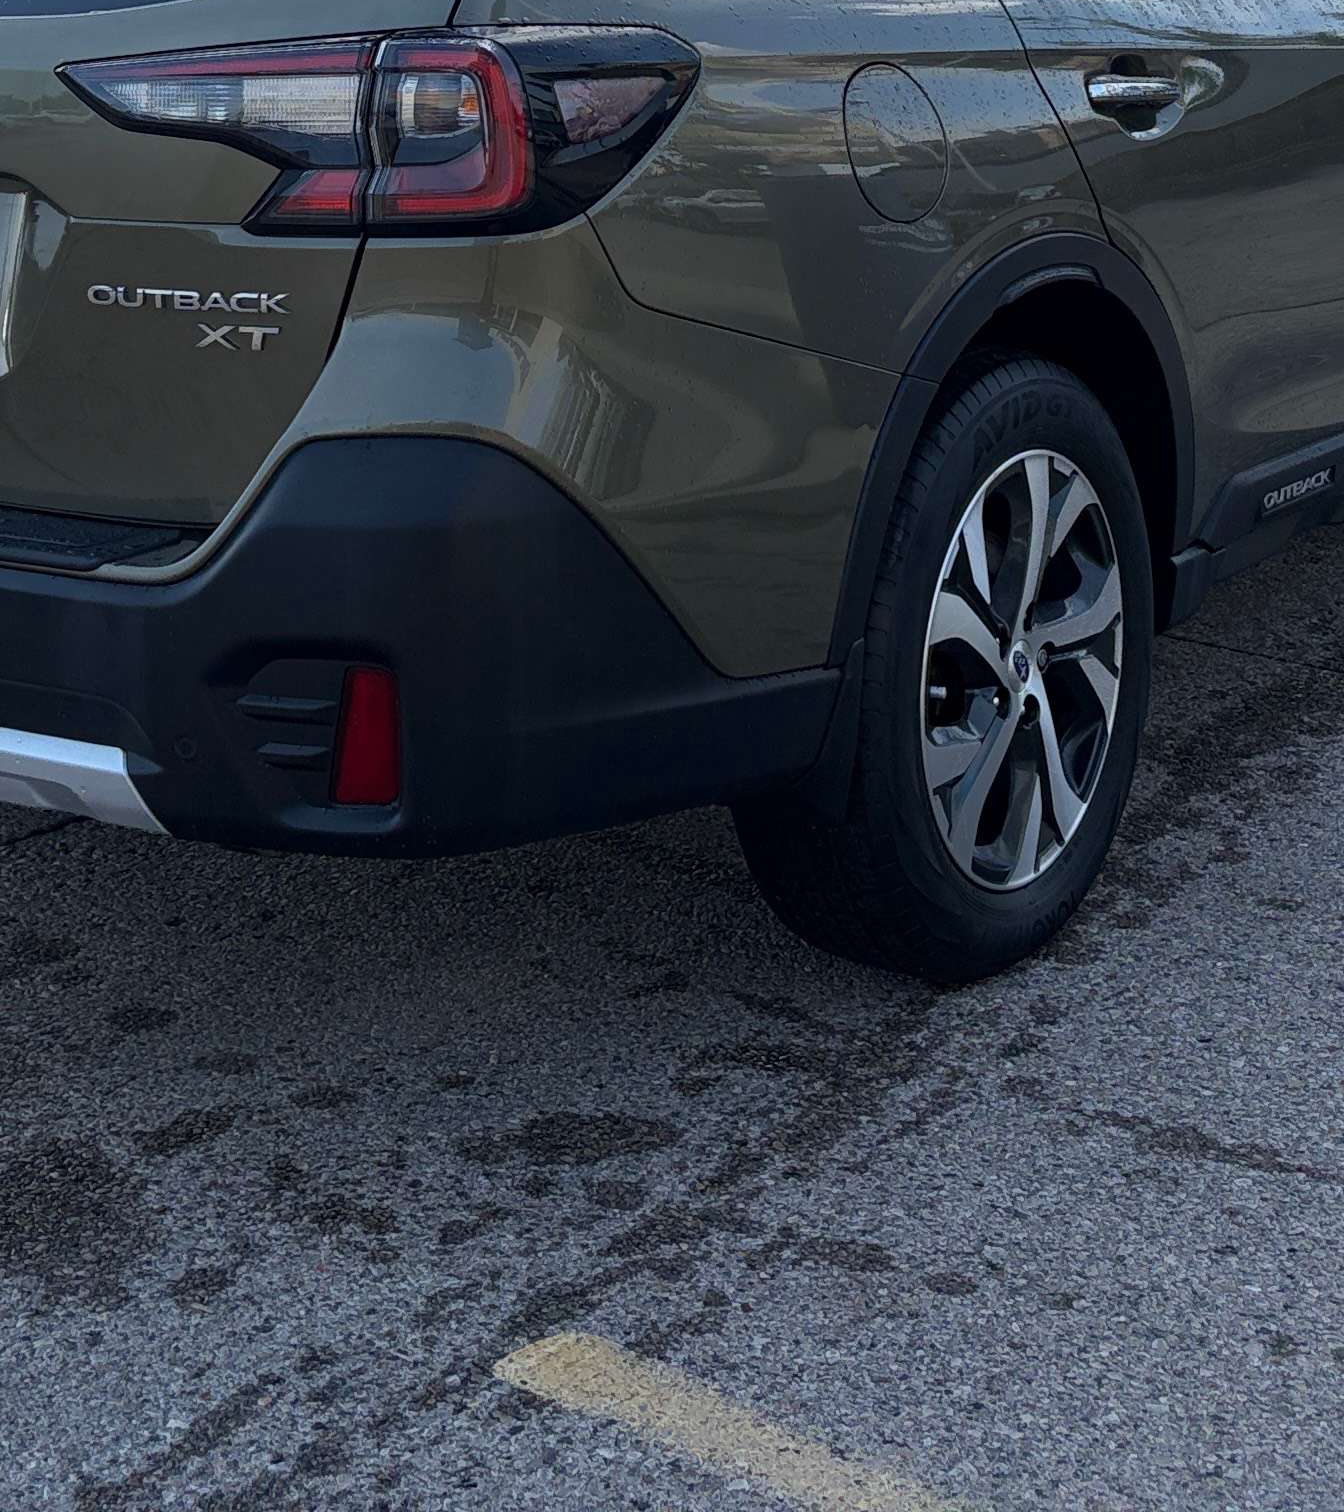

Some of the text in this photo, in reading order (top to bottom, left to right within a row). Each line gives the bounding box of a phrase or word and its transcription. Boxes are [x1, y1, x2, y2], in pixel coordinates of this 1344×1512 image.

[87, 285, 292, 314] OUTBACK
[195, 323, 280, 351] XT
[1263, 468, 1332, 509] OUTBACK
